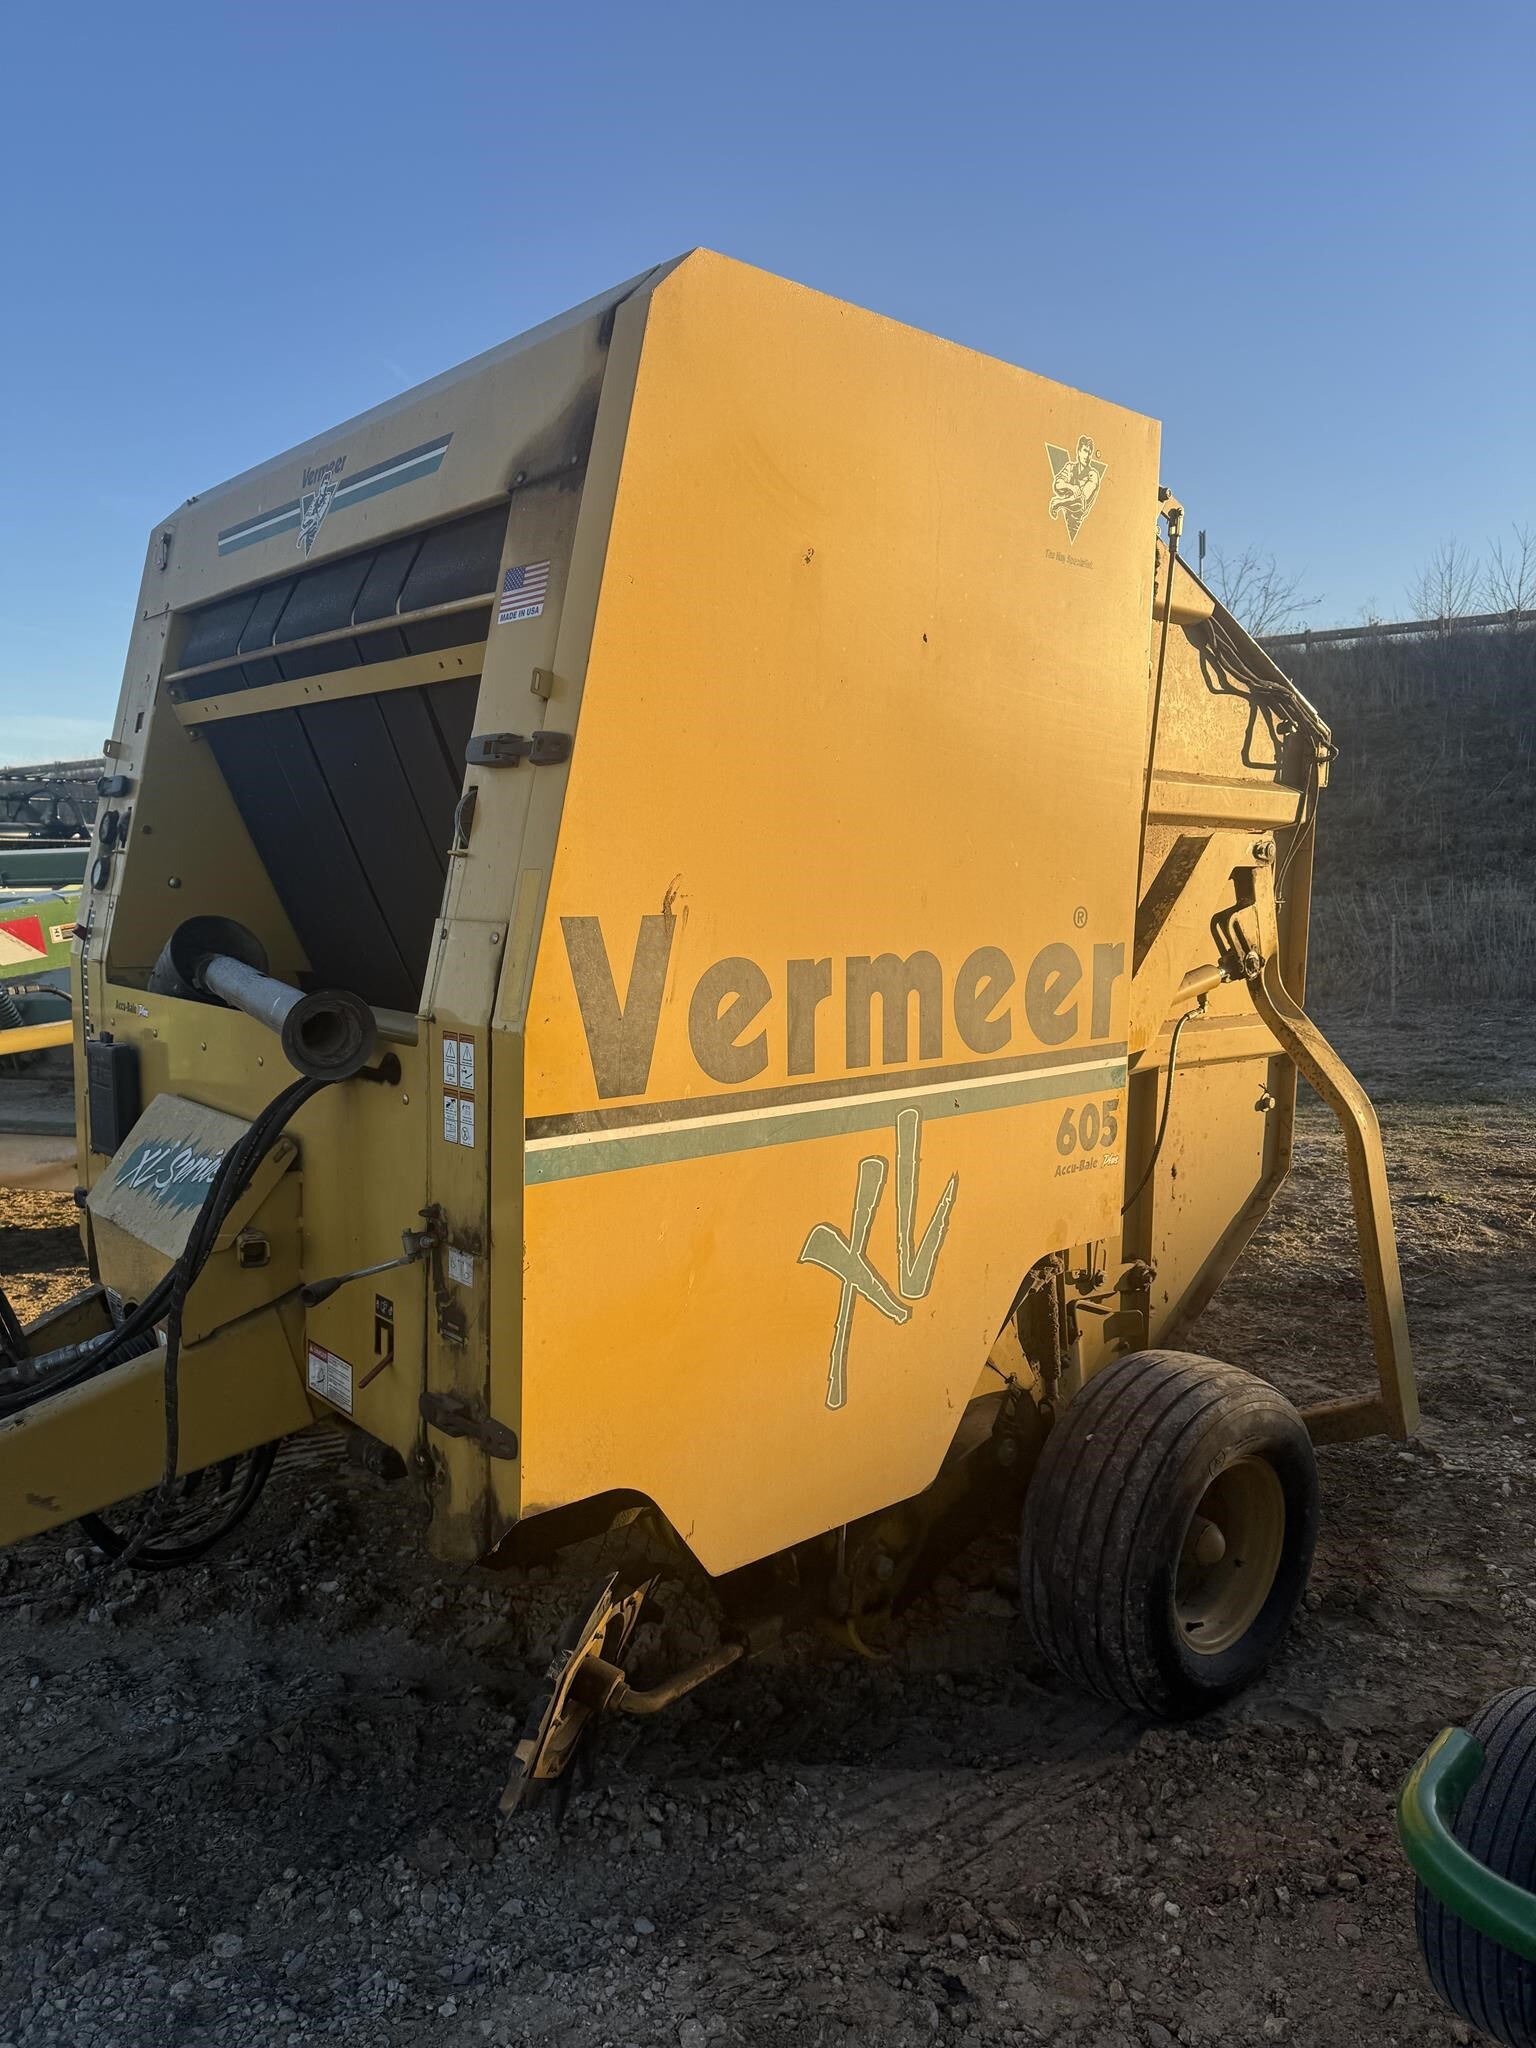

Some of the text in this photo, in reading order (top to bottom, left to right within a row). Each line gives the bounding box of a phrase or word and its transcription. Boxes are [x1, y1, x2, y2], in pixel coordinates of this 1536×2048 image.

[302, 455, 347, 488] Vermeer
[500, 606, 539, 621] MADE IN USA
[560, 914, 1125, 1100] Vermeer
[1056, 1098, 1120, 1156] 605
[1054, 1157, 1098, 1178] Accu-Bale
